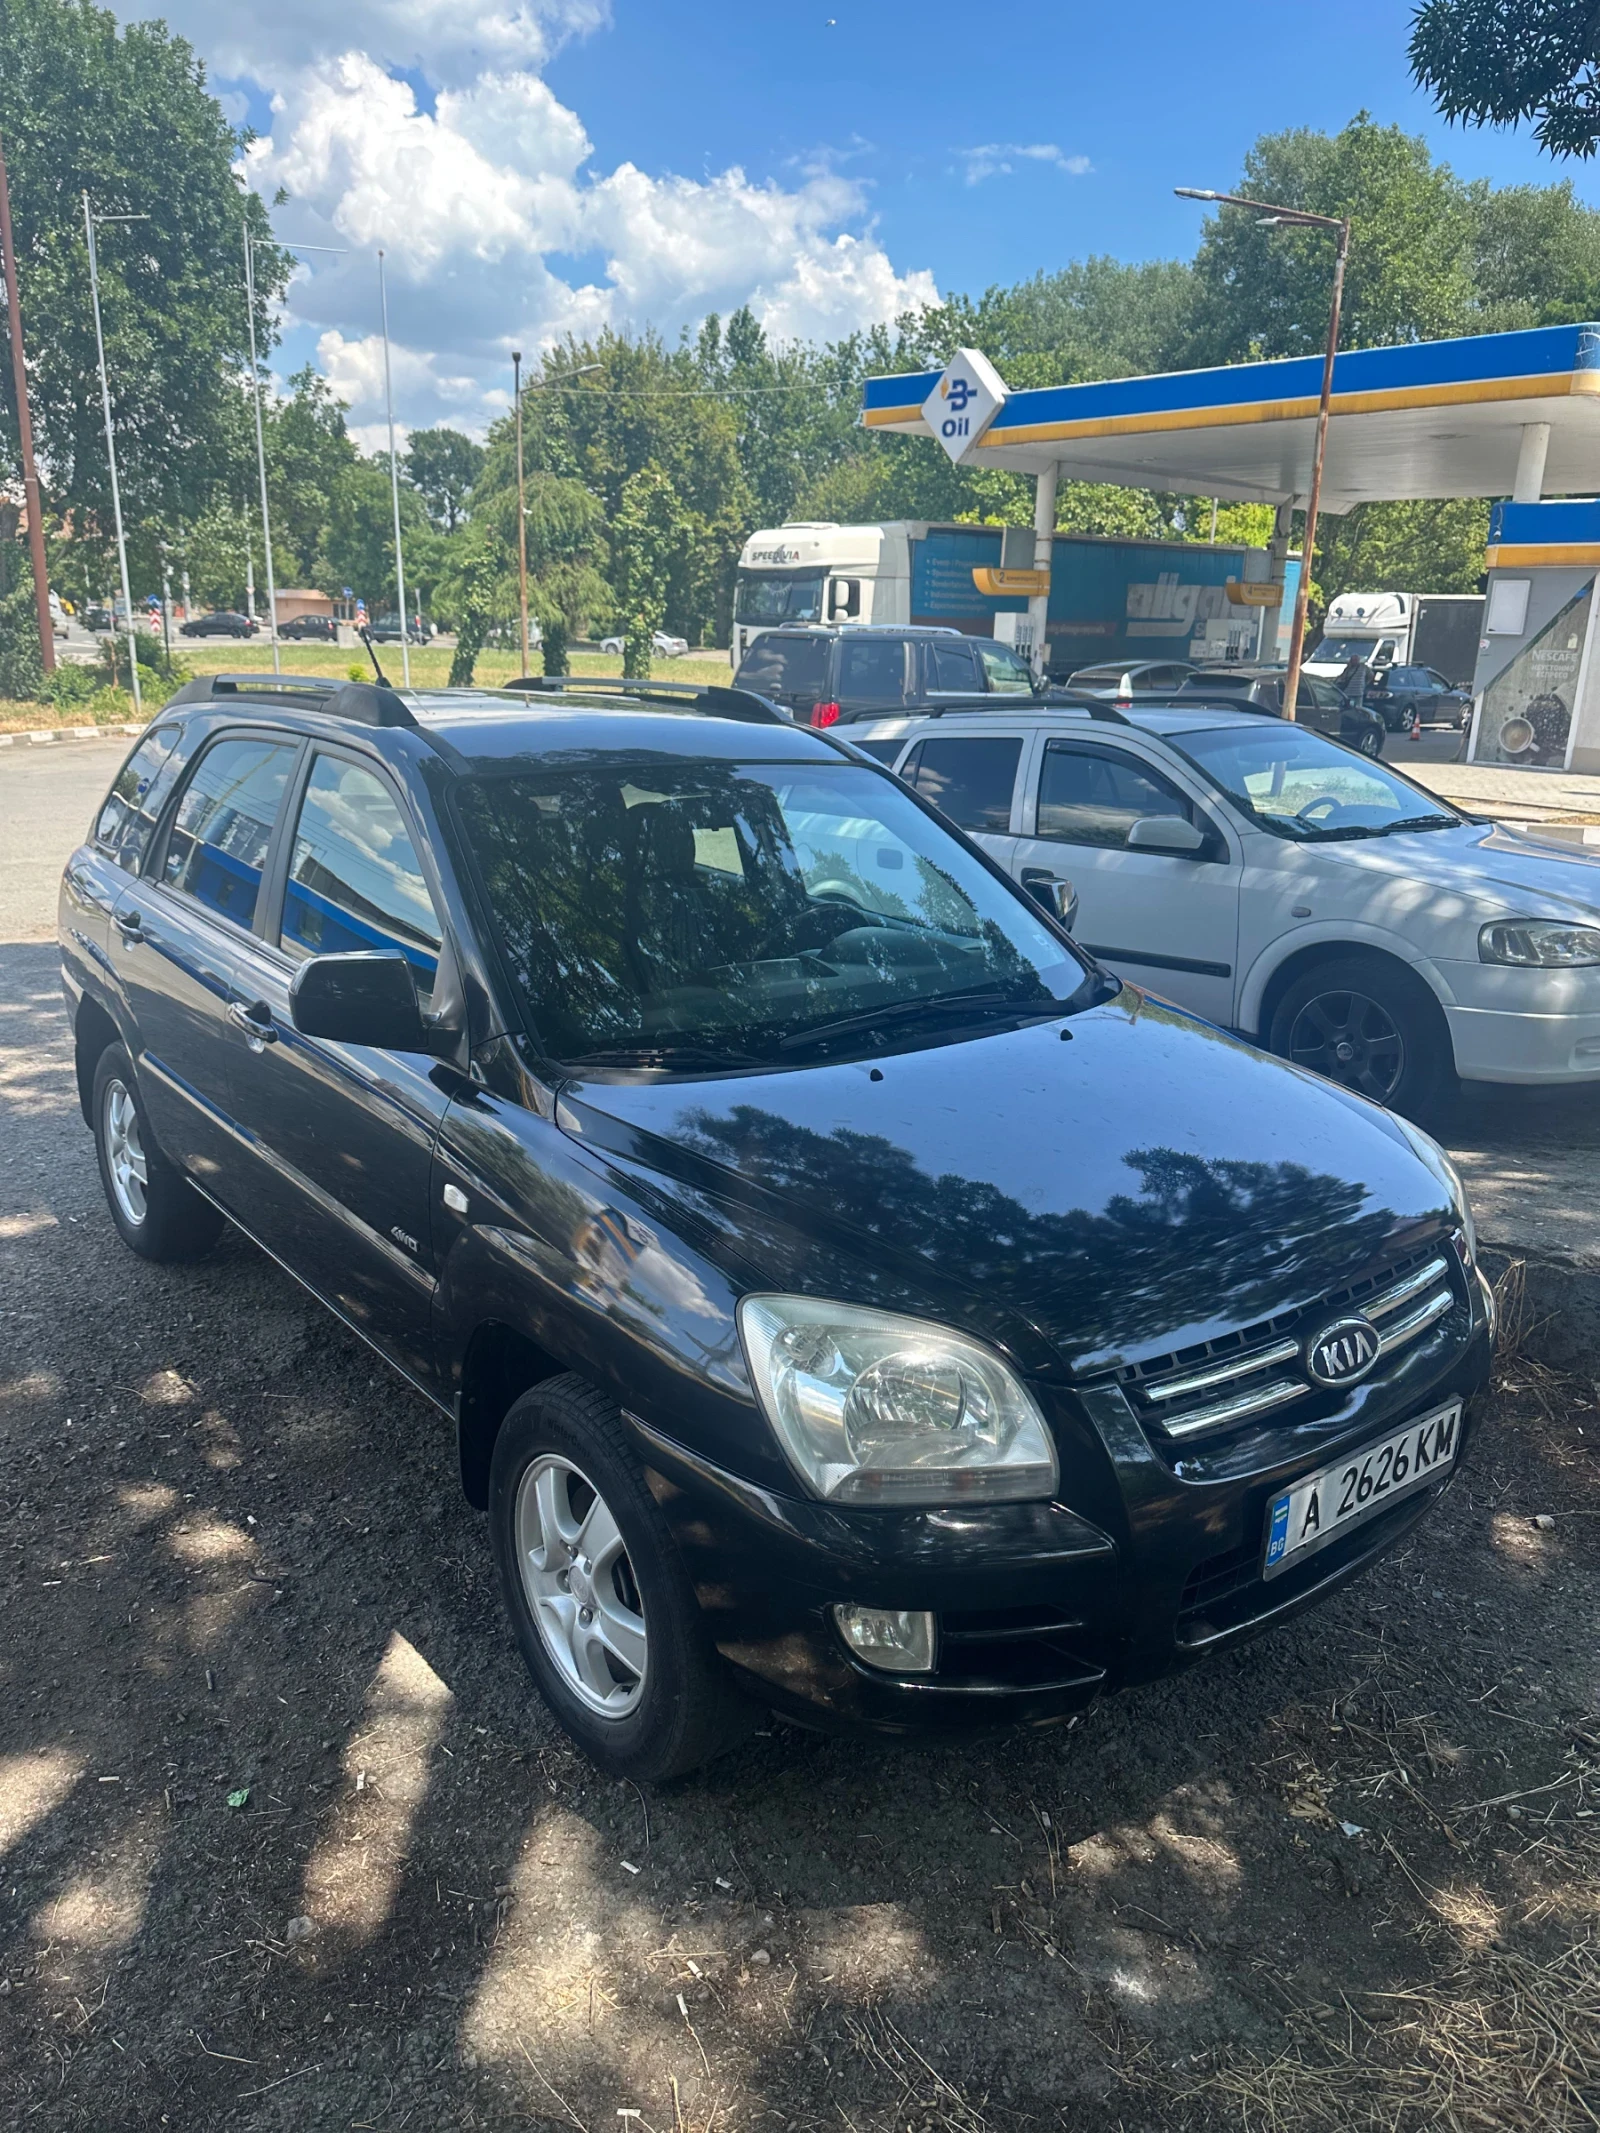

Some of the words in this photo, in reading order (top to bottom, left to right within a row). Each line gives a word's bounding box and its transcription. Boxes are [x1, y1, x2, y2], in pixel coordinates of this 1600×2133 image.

[999, 571, 1005, 583] 2
[1320, 1331, 1373, 1376] KIA
[1301, 1487, 1320, 1538] A
[1336, 1435, 1410, 1518] 2626
[1414, 1411, 1456, 1474] KM
[1270, 1537, 1285, 1557] BG
